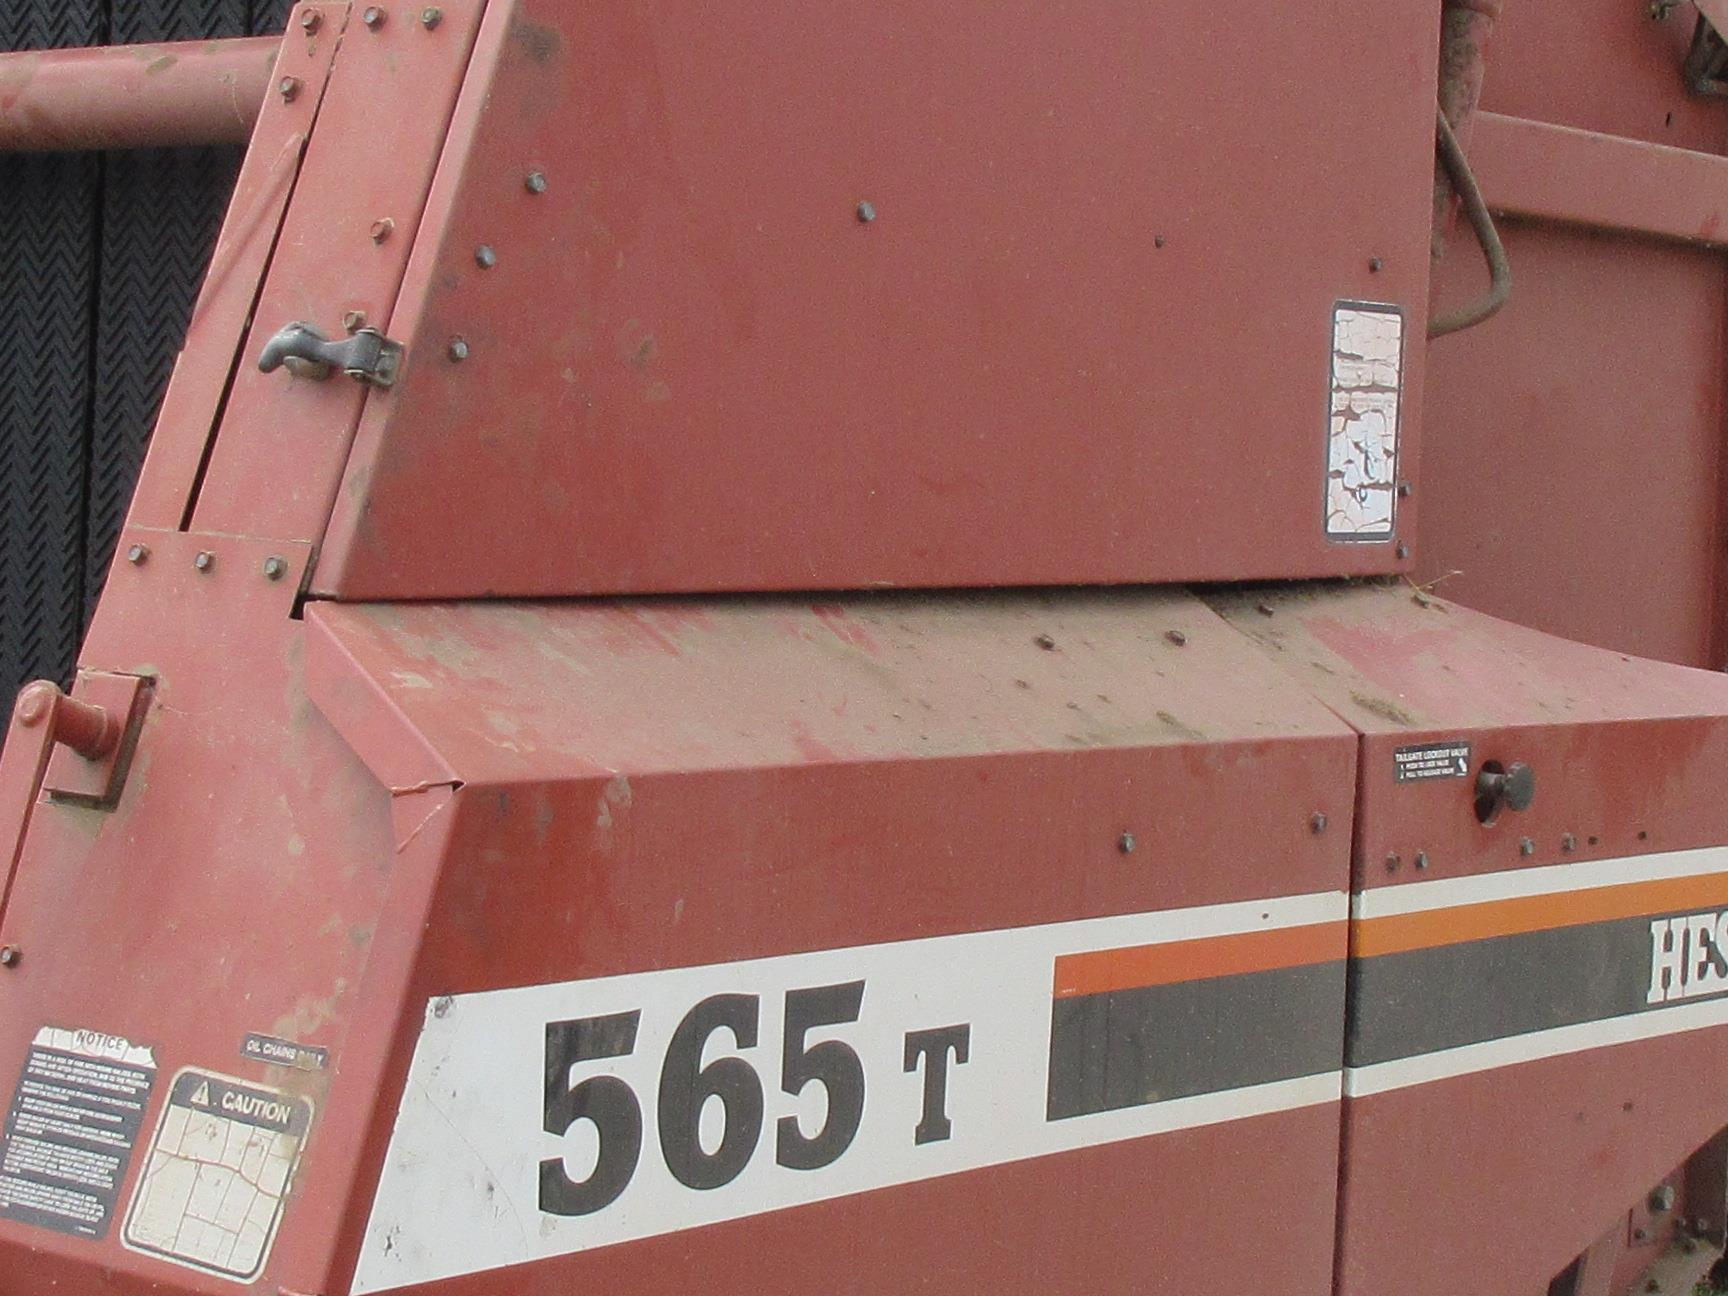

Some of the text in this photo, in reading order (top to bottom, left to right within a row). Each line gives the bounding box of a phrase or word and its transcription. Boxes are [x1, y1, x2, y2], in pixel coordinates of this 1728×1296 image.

[75, 1030, 123, 1051] NOTICE
[221, 1090, 292, 1124] CAUTION
[538, 979, 971, 1217] 565 T
